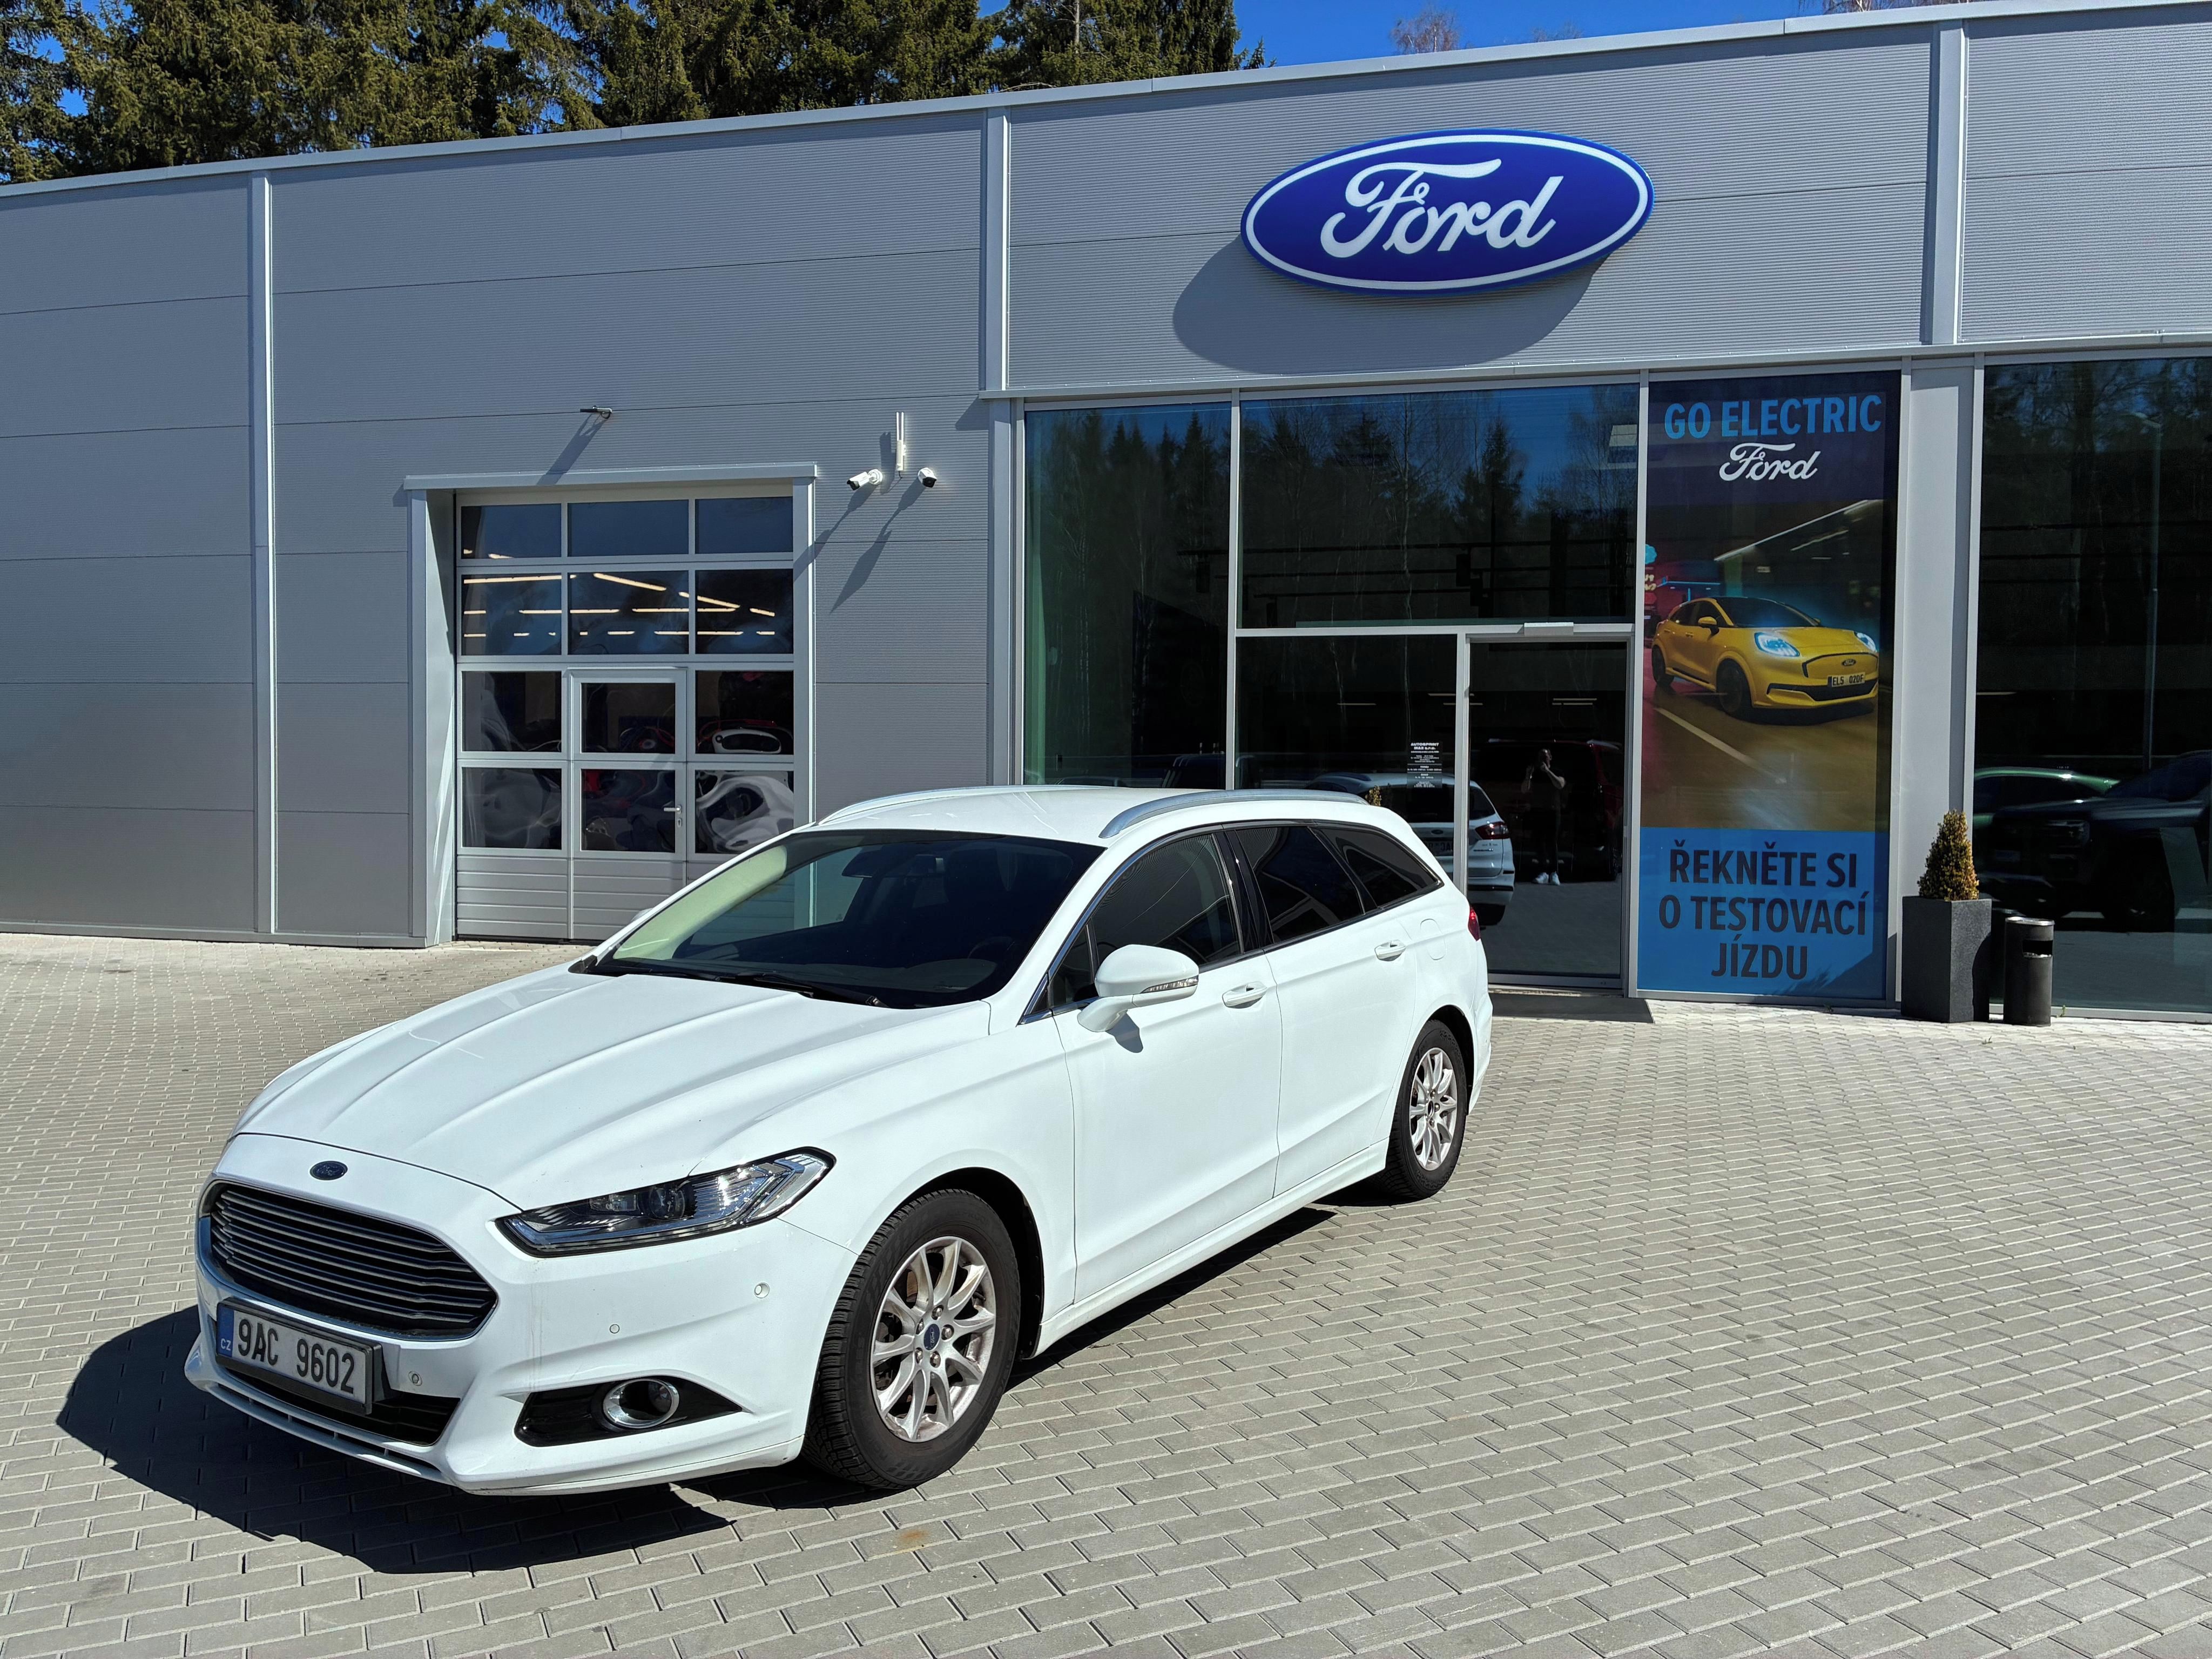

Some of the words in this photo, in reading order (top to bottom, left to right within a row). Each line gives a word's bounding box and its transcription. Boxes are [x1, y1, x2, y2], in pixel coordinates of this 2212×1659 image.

[1320, 158, 1564, 258] Ford
[1664, 402, 1711, 439] GO
[1721, 395, 1882, 437] ELECTRIC
[1719, 442, 1821, 481] Ford
[1669, 839, 1817, 886] ŘEKNĚTE
[1826, 853, 1857, 888] SI
[1658, 894, 1681, 929] O
[1690, 891, 1870, 935] TESTOVACÍ
[1711, 934, 1808, 980] JÍZDU
[220, 1338, 231, 1351] CZ
[238, 1319, 279, 1366] 9AC
[296, 1338, 354, 1394] 9602
